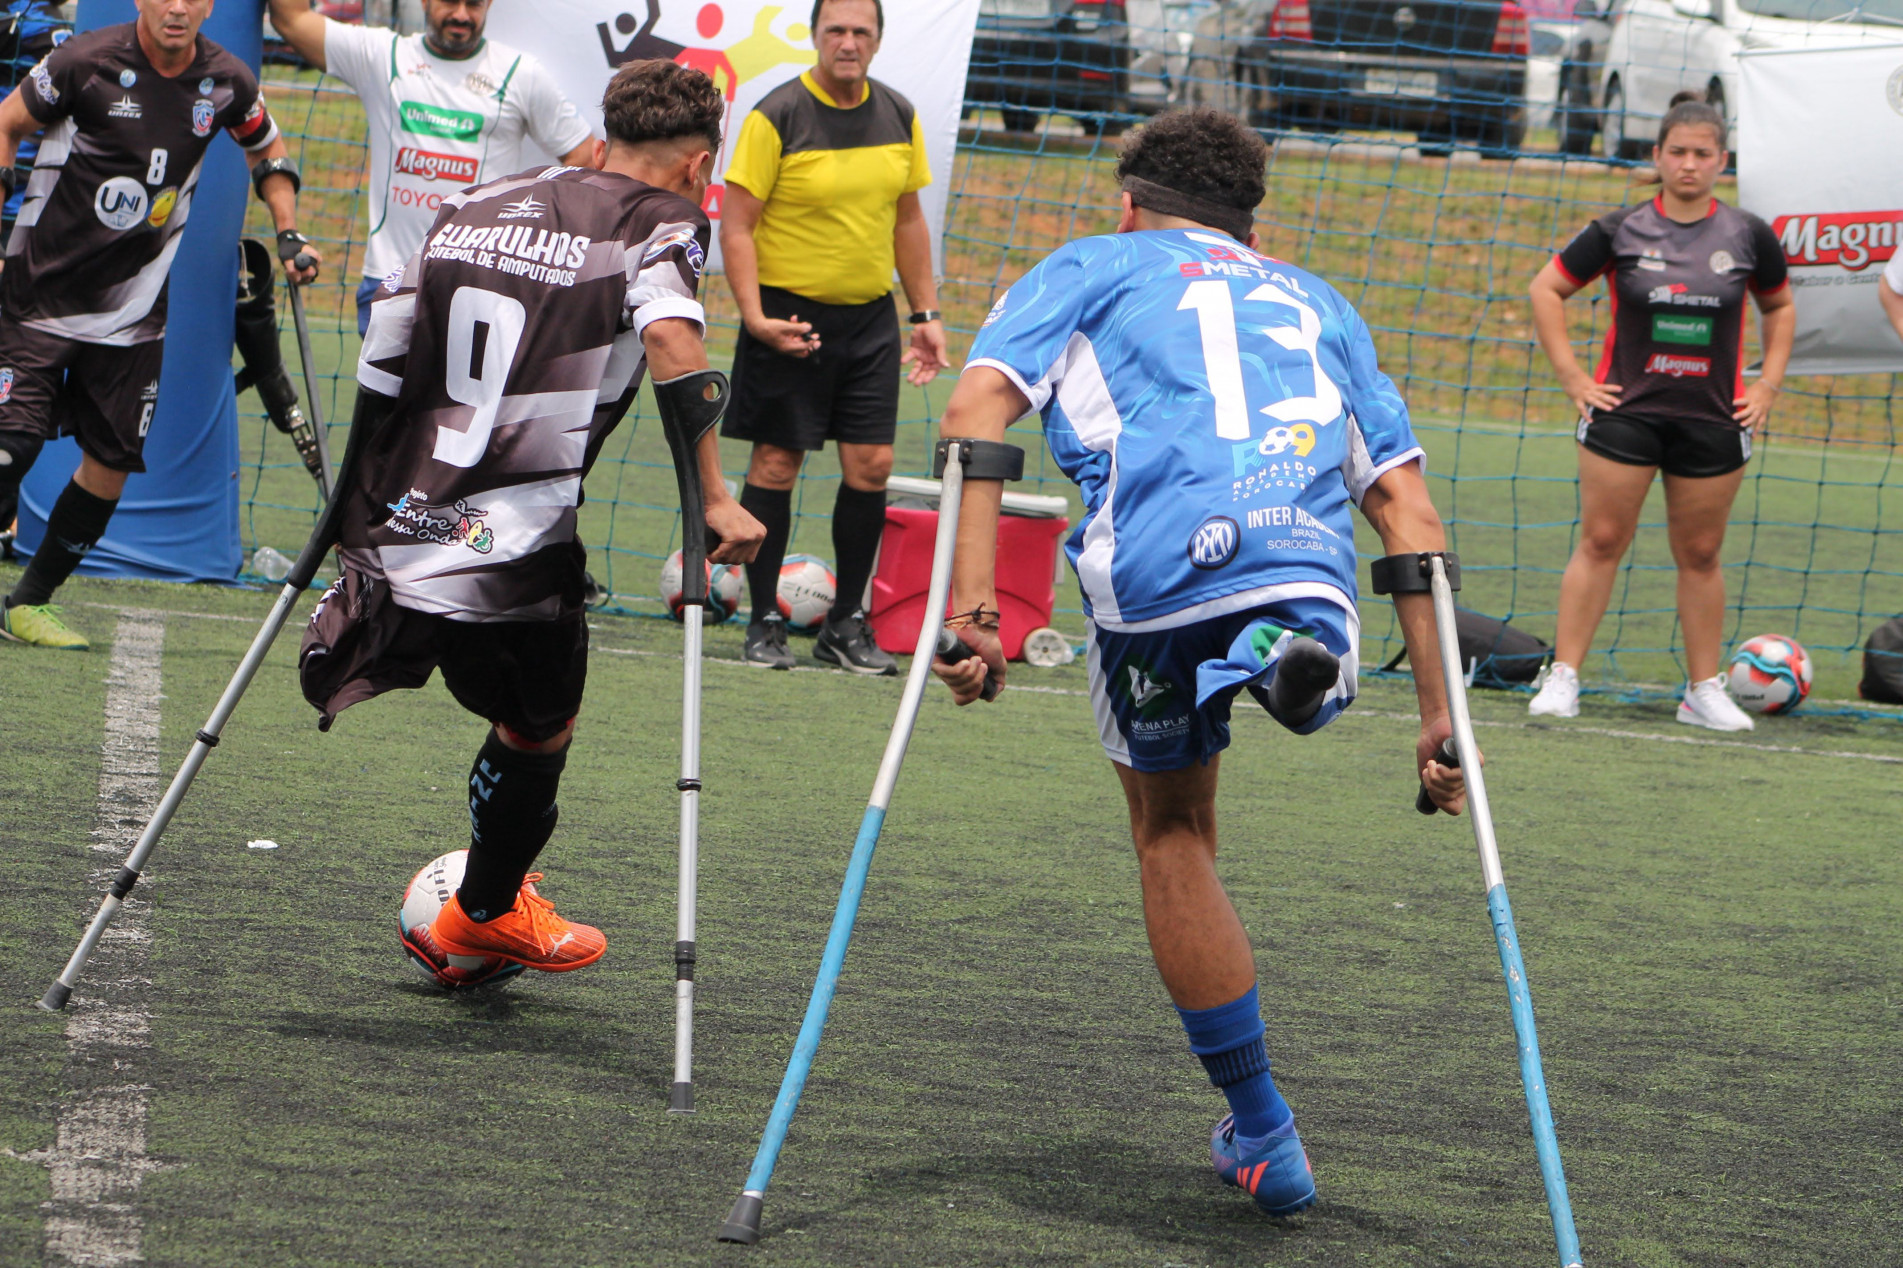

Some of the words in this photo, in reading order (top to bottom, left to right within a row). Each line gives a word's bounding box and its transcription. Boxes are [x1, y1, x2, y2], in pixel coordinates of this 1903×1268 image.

[406, 108, 458, 128] Unimed
[146, 148, 168, 186] 8
[394, 149, 475, 181] Magnus
[100, 186, 142, 214] UNI
[392, 187, 448, 211] TOYO
[428, 223, 592, 269] GUARULHOS
[423, 245, 475, 264] FUTEBOL
[474, 250, 497, 268] DE
[497, 256, 577, 287] AMPUTADOS
[1179, 261, 1309, 299] SMETAL
[1176, 280, 1343, 441] 13
[1644, 354, 1709, 377] Magnus
[432, 286, 527, 468] 9
[138, 402, 154, 437] 8
[1233, 461, 1317, 490] RONALDO
[1232, 479, 1307, 502] SOROCAB
[1247, 506, 1292, 529] INTER
[1267, 539, 1325, 553] SOROCABA
[1291, 528, 1322, 540] BRAZIL
[1162, 714, 1190, 729] PLAY
